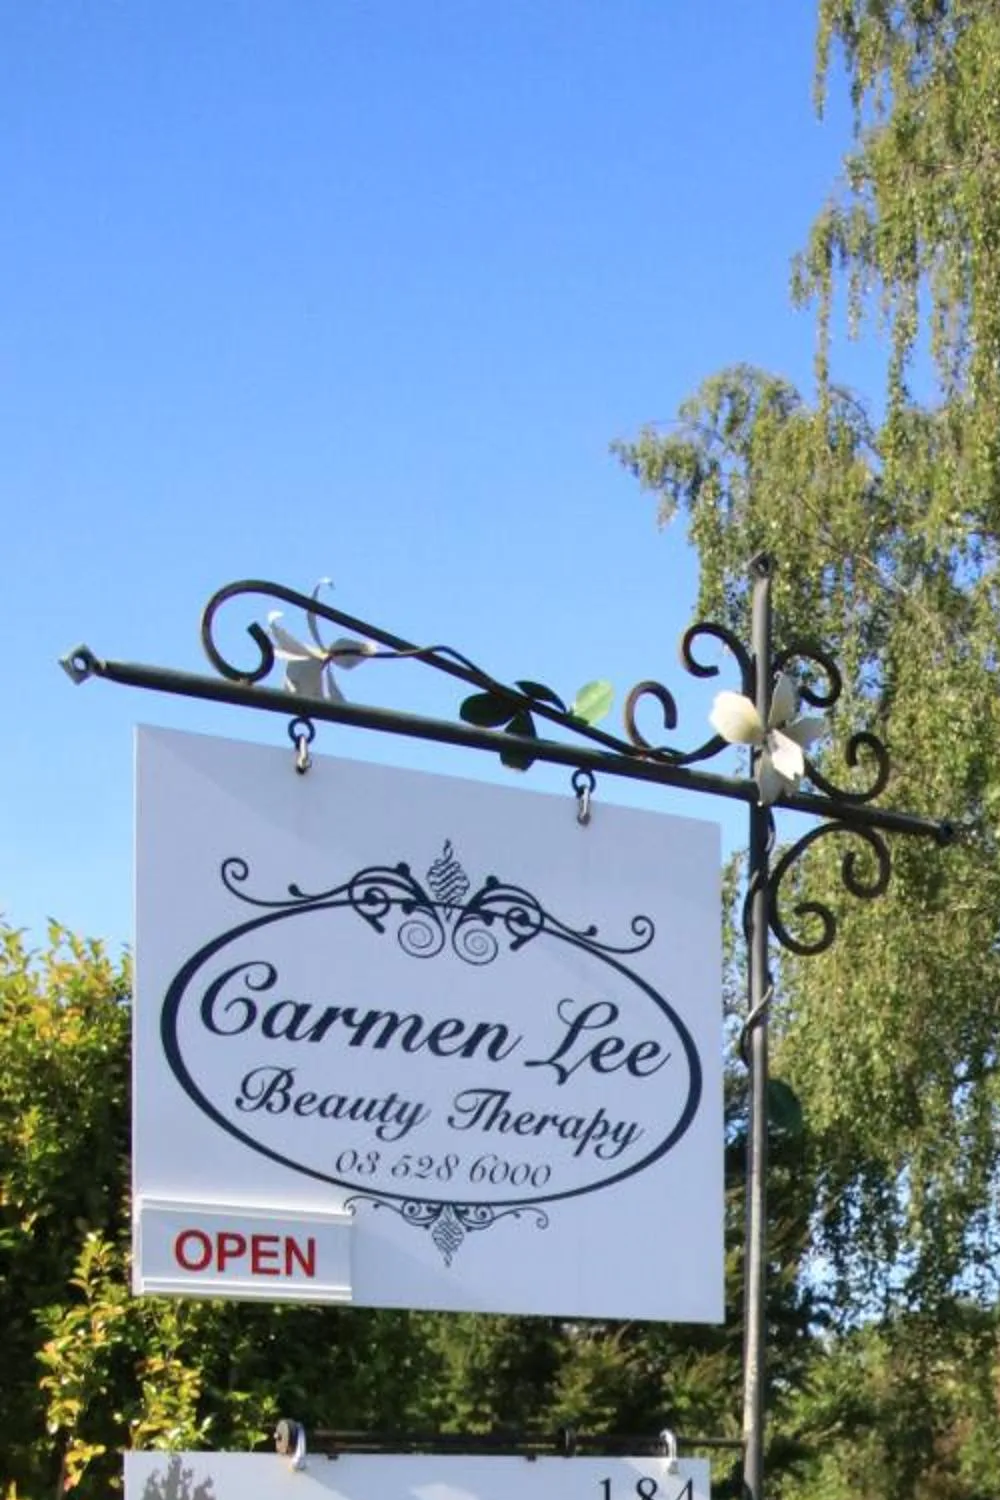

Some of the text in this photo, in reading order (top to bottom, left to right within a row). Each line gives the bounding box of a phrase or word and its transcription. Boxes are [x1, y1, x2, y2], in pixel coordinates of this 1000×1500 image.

[198, 960, 672, 1086] Carmen Lee
[233, 1064, 646, 1160] Beauty Therapy
[333, 1147, 552, 1188] 03 528 6000
[174, 1228, 318, 1279] OPEN
